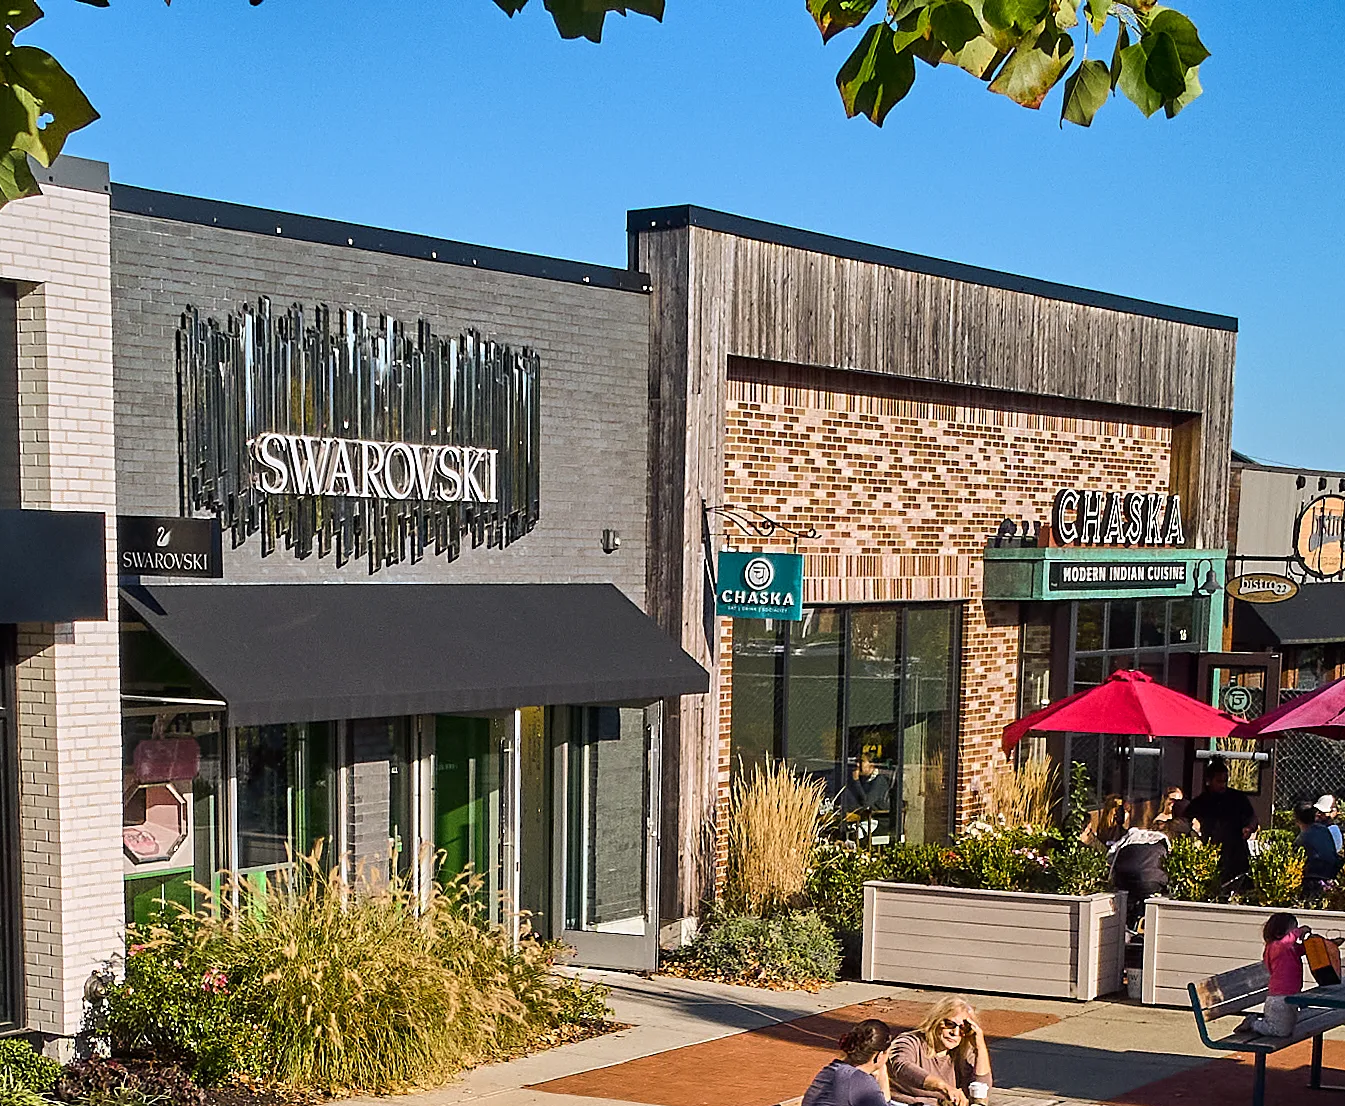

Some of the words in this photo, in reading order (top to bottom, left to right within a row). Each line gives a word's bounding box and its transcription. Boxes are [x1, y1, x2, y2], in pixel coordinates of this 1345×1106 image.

[258, 432, 499, 503] SWAROVSKI
[1057, 487, 1186, 546] CHASKA
[122, 551, 208, 571] SWAROVSKI
[1063, 565, 1106, 582] MODERN
[1109, 564, 1146, 581] INDIAN
[1147, 564, 1185, 581] CUISINE
[721, 589, 795, 606] CHASKA
[1276, 583, 1288, 594] 22
